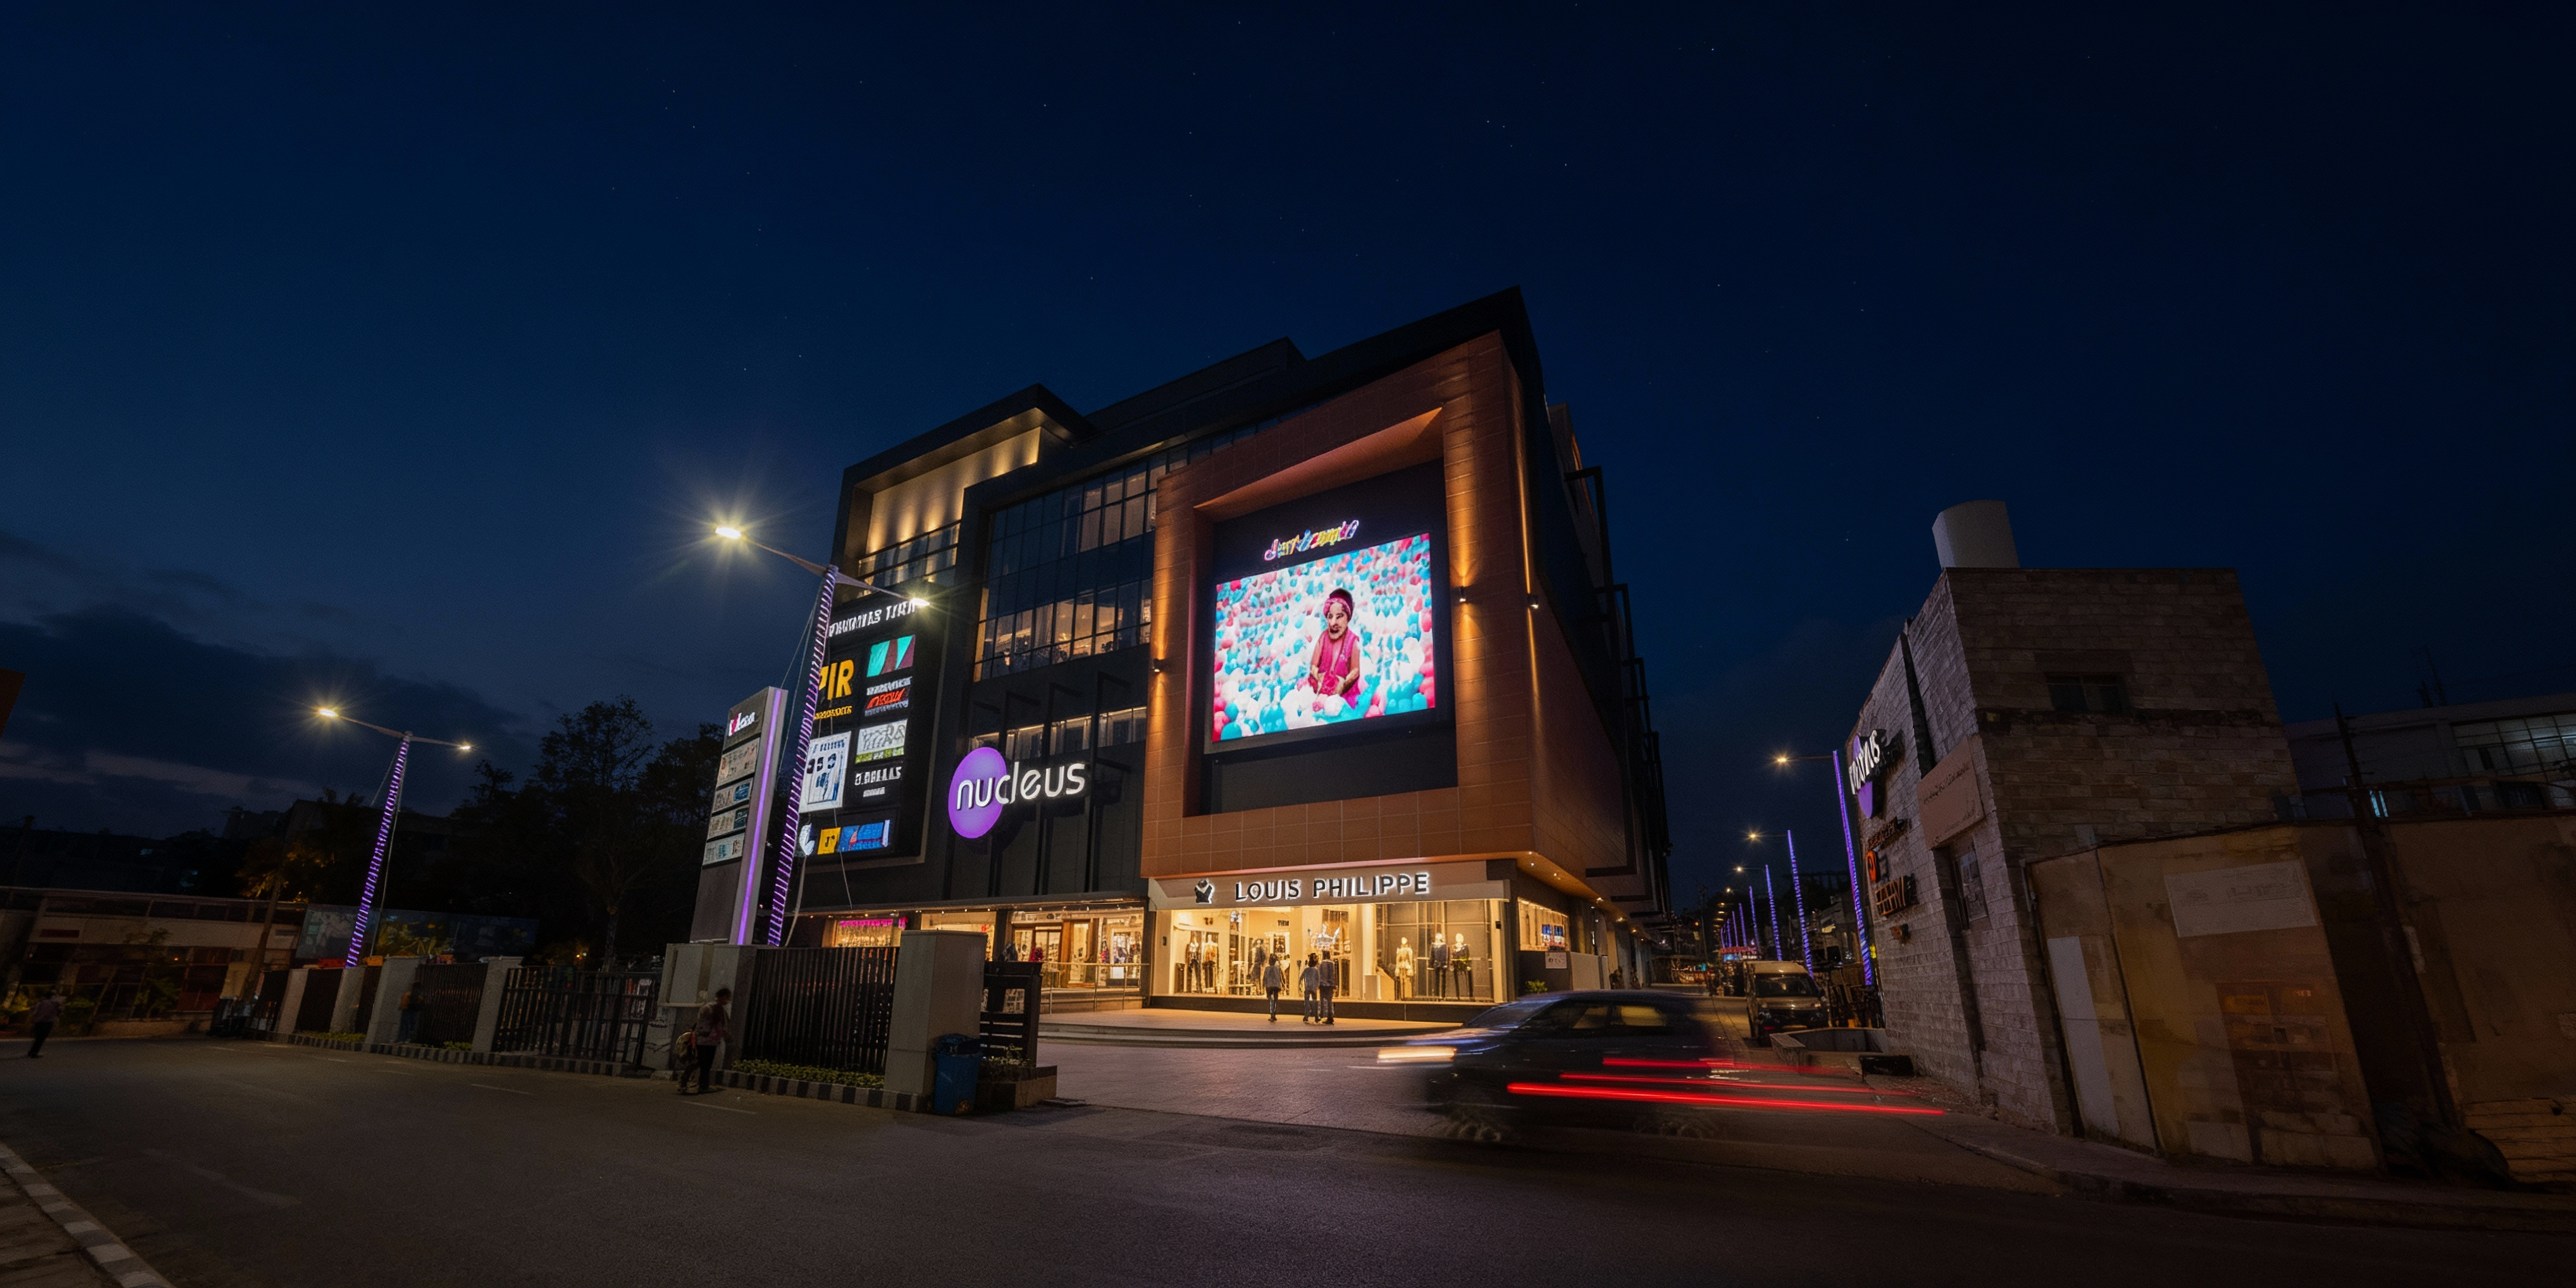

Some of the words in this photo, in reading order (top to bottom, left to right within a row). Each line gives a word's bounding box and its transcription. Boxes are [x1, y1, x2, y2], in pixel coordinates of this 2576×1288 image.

[957, 762, 1085, 810] nucleus
[1235, 879, 1302, 901] LOUIS
[1313, 872, 1430, 898] PHILIPPE
